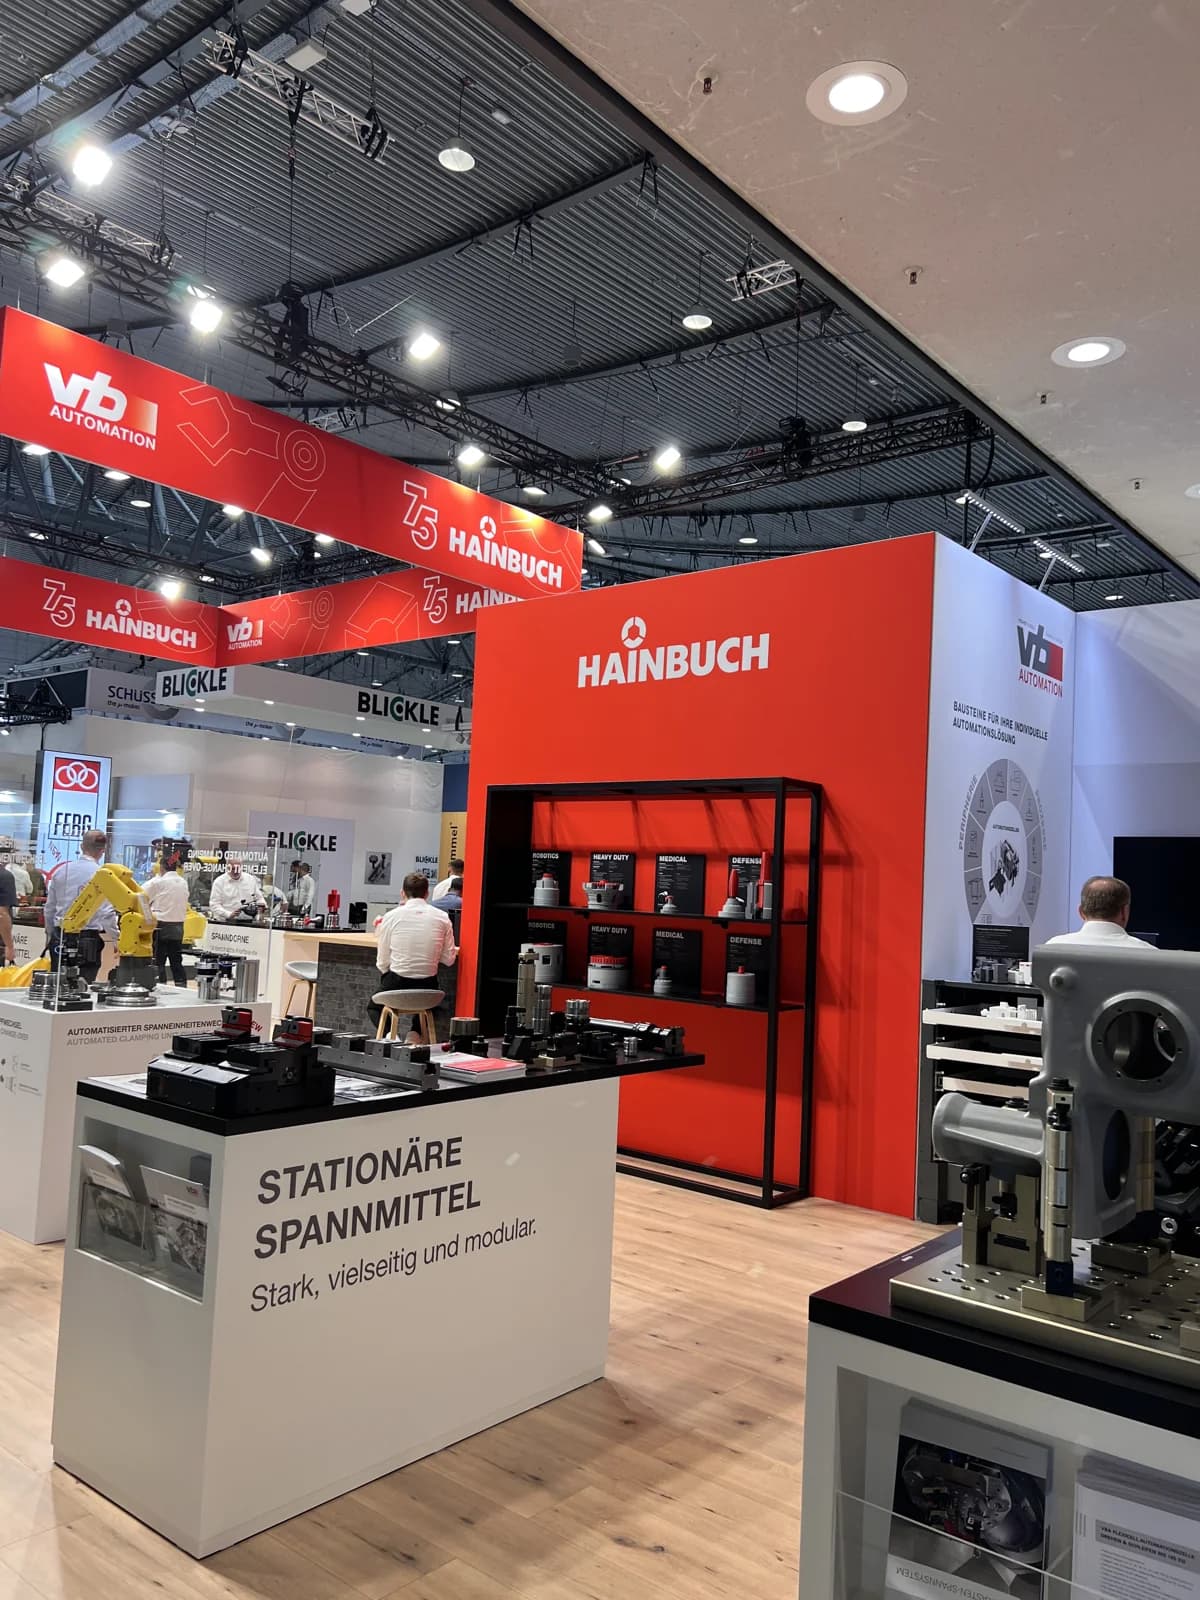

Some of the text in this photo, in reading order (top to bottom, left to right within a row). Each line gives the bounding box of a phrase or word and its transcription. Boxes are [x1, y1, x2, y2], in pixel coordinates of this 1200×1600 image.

[50, 404, 156, 450] AUTOMATION
[403, 480, 438, 550] 75
[449, 527, 562, 588] HAINBUCH
[43, 578, 76, 628] 75
[423, 576, 448, 624] 75
[86, 609, 197, 649] HAINBUCH
[228, 639, 263, 650] AUTOMATION
[577, 633, 770, 688] HAINBUCH
[162, 668, 227, 697] BLICKLE
[1019, 668, 1063, 698] AUTOMATION
[357, 691, 440, 726] BLICKLE
[953, 700, 1049, 741] BAUSTEINE FÜR IHRE INDIVIDUELLE
[952, 716, 1017, 745] AUTOMATIONSLÖSUNG
[266, 831, 337, 852] BLICKLE
[532, 852, 560, 860] ROBOTICS
[592, 853, 612, 861] HEAVY
[659, 855, 688, 863] MEDICAL
[528, 921, 556, 929] ROBOTICS
[591, 925, 611, 933] HEAVY
[655, 930, 685, 939] MEDICAL
[730, 936, 763, 946] DEFENSE
[66, 1035, 118, 1047] AUTOMATED
[119, 1033, 159, 1044] CLAMPING
[67, 1018, 222, 1036] AUTOMATISIERTER SPANNEINHEITENWEC
[250, 1020, 263, 1033] EW
[257, 1136, 463, 1205] STATIONÄRE
[253, 1180, 481, 1259] SPANNMITTEL
[250, 1218, 537, 1312] Stark, vielseitig und modular.
